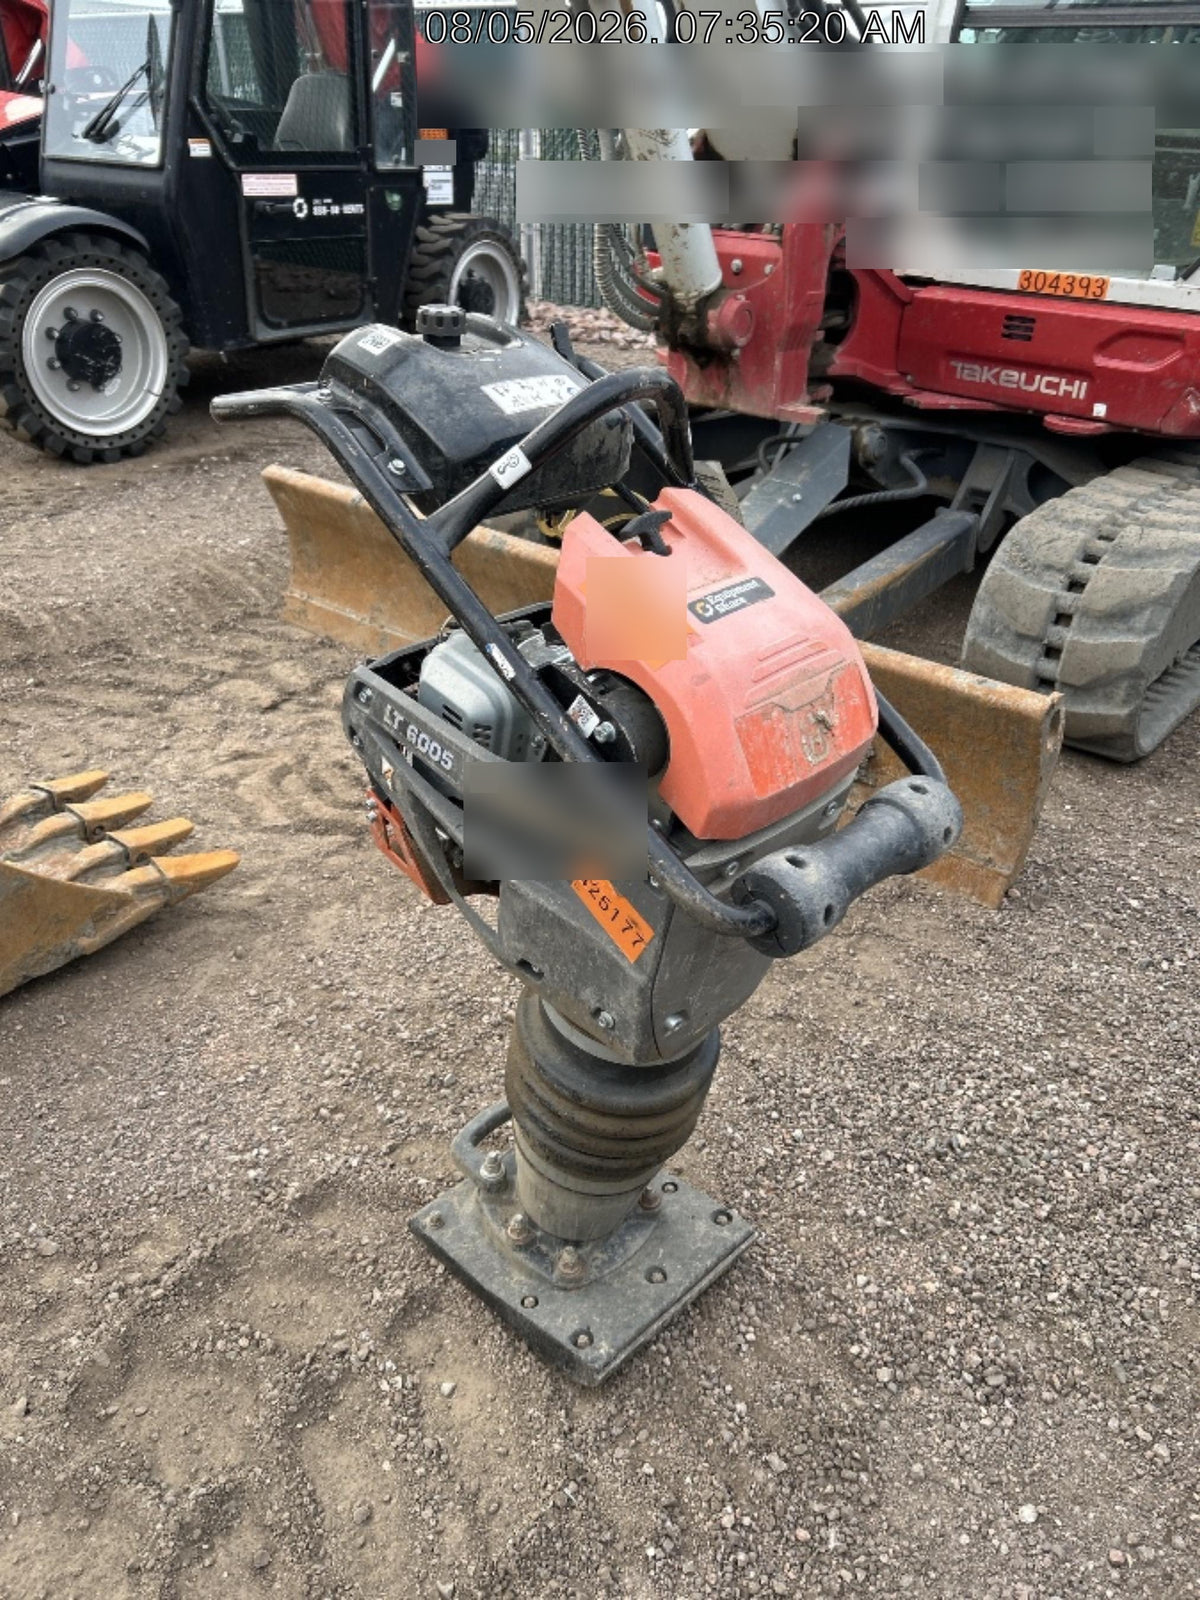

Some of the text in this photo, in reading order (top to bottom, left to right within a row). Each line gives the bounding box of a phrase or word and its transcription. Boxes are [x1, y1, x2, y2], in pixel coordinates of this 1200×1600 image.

[1020, 269, 1106, 297] 304393
[706, 579, 761, 605] Equipment
[714, 597, 748, 614] Share
[383, 703, 454, 770] LT 6005
